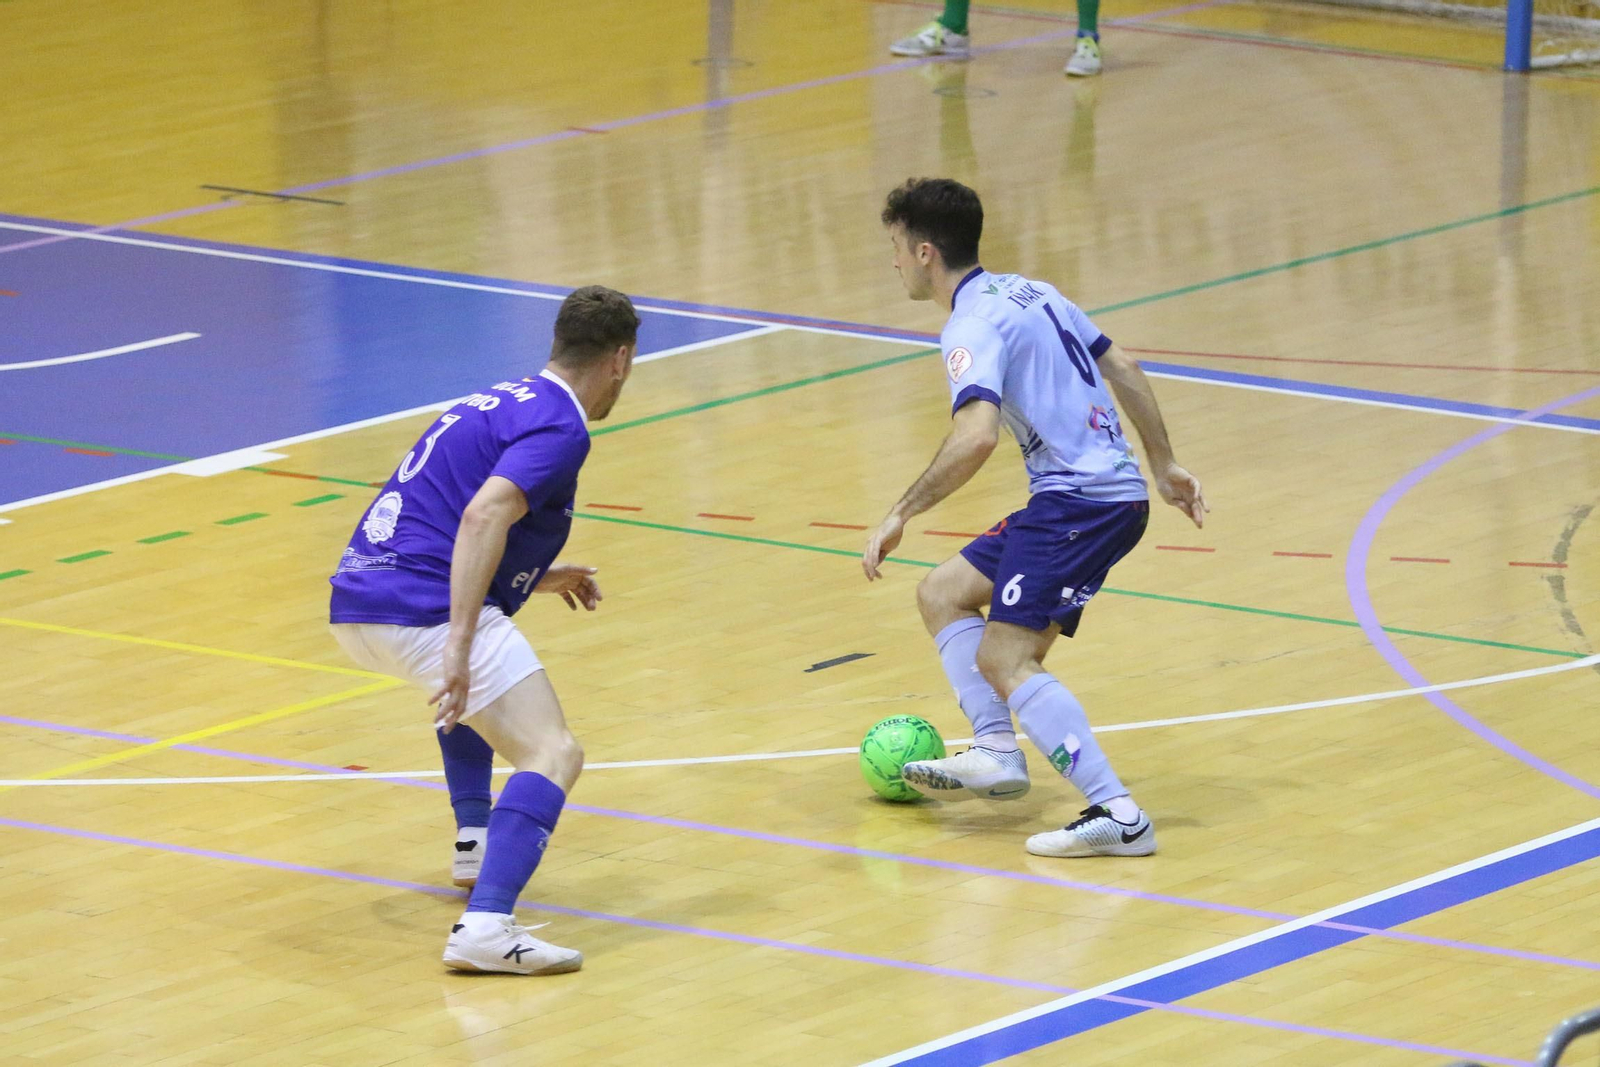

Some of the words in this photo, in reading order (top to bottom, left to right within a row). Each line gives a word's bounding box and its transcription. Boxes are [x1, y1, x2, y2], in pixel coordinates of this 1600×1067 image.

[1042, 302, 1096, 388] 6
[398, 413, 461, 483] 3
[1001, 573, 1025, 606] 6
